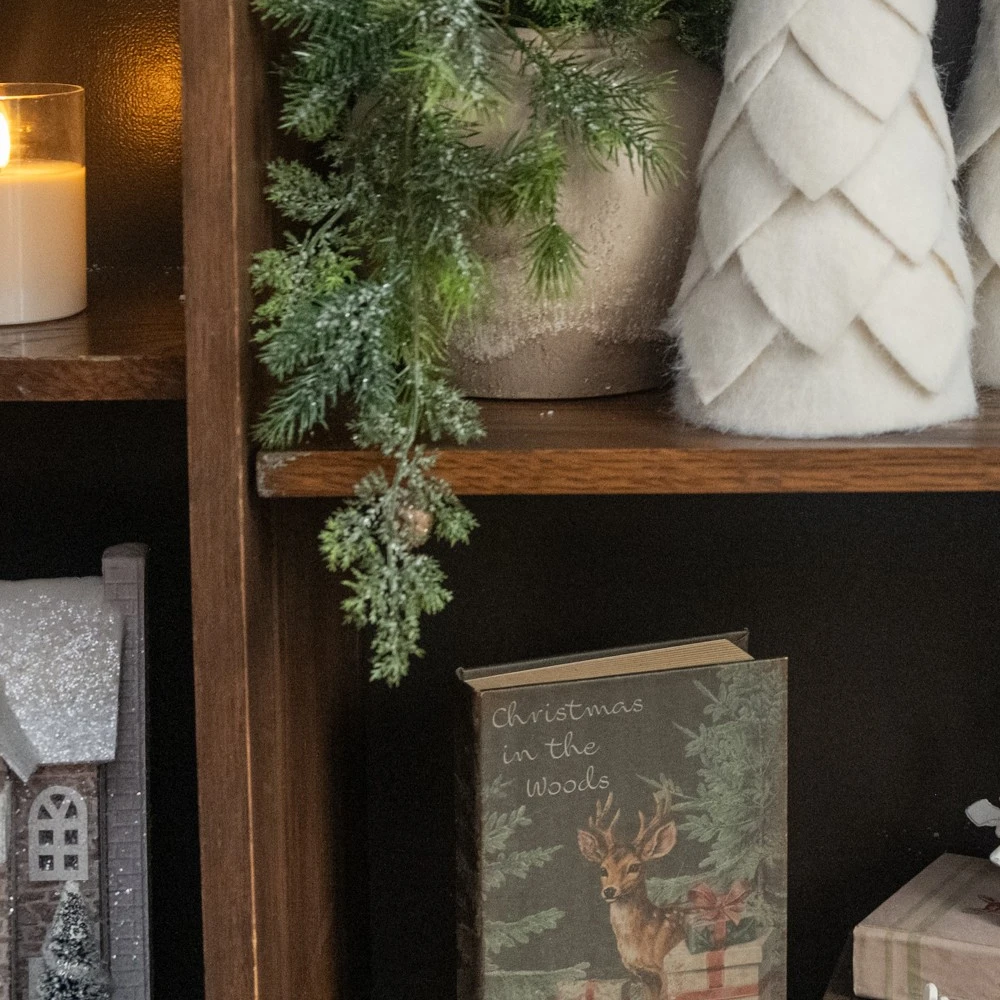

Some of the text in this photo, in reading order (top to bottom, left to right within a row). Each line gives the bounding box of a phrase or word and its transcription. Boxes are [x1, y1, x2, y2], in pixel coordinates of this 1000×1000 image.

[491, 697, 645, 729] Christmas
[502, 731, 601, 765] in the
[526, 765, 610, 798] Woods
